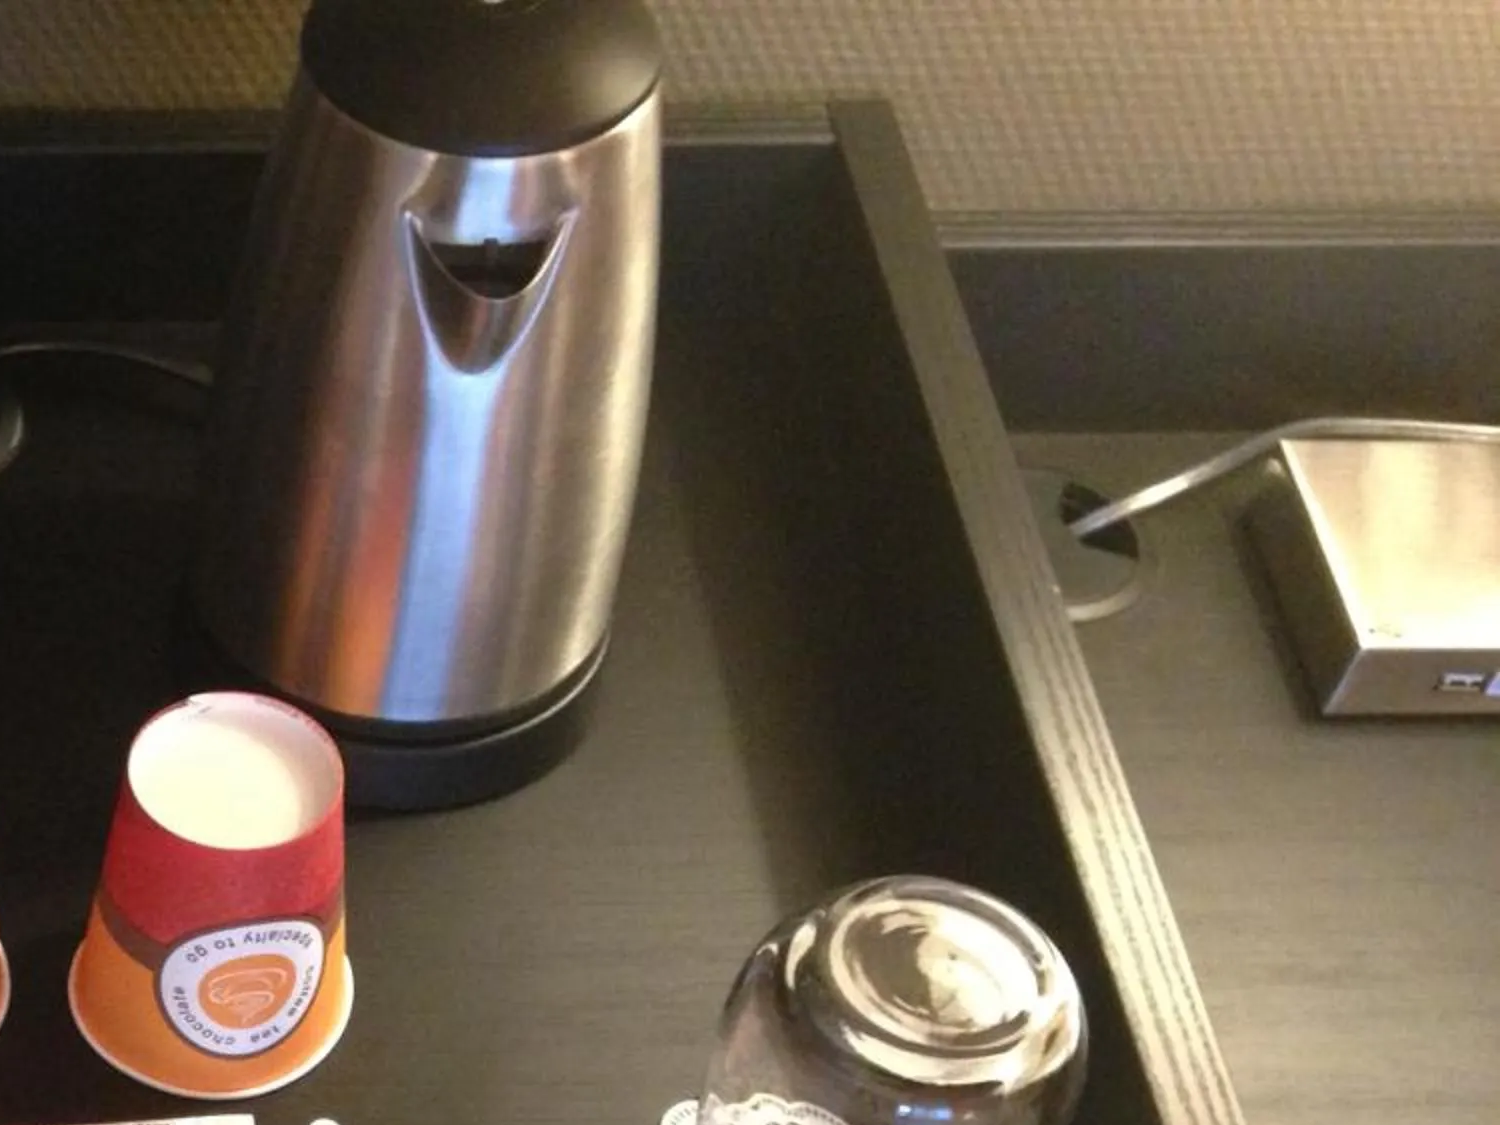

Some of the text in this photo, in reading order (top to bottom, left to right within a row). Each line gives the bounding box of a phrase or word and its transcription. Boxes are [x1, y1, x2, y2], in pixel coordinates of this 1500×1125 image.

[214, 937, 235, 950] to
[187, 945, 208, 963] go
[172, 986, 236, 1045] chocolate
[250, 1025, 281, 1043] tea
